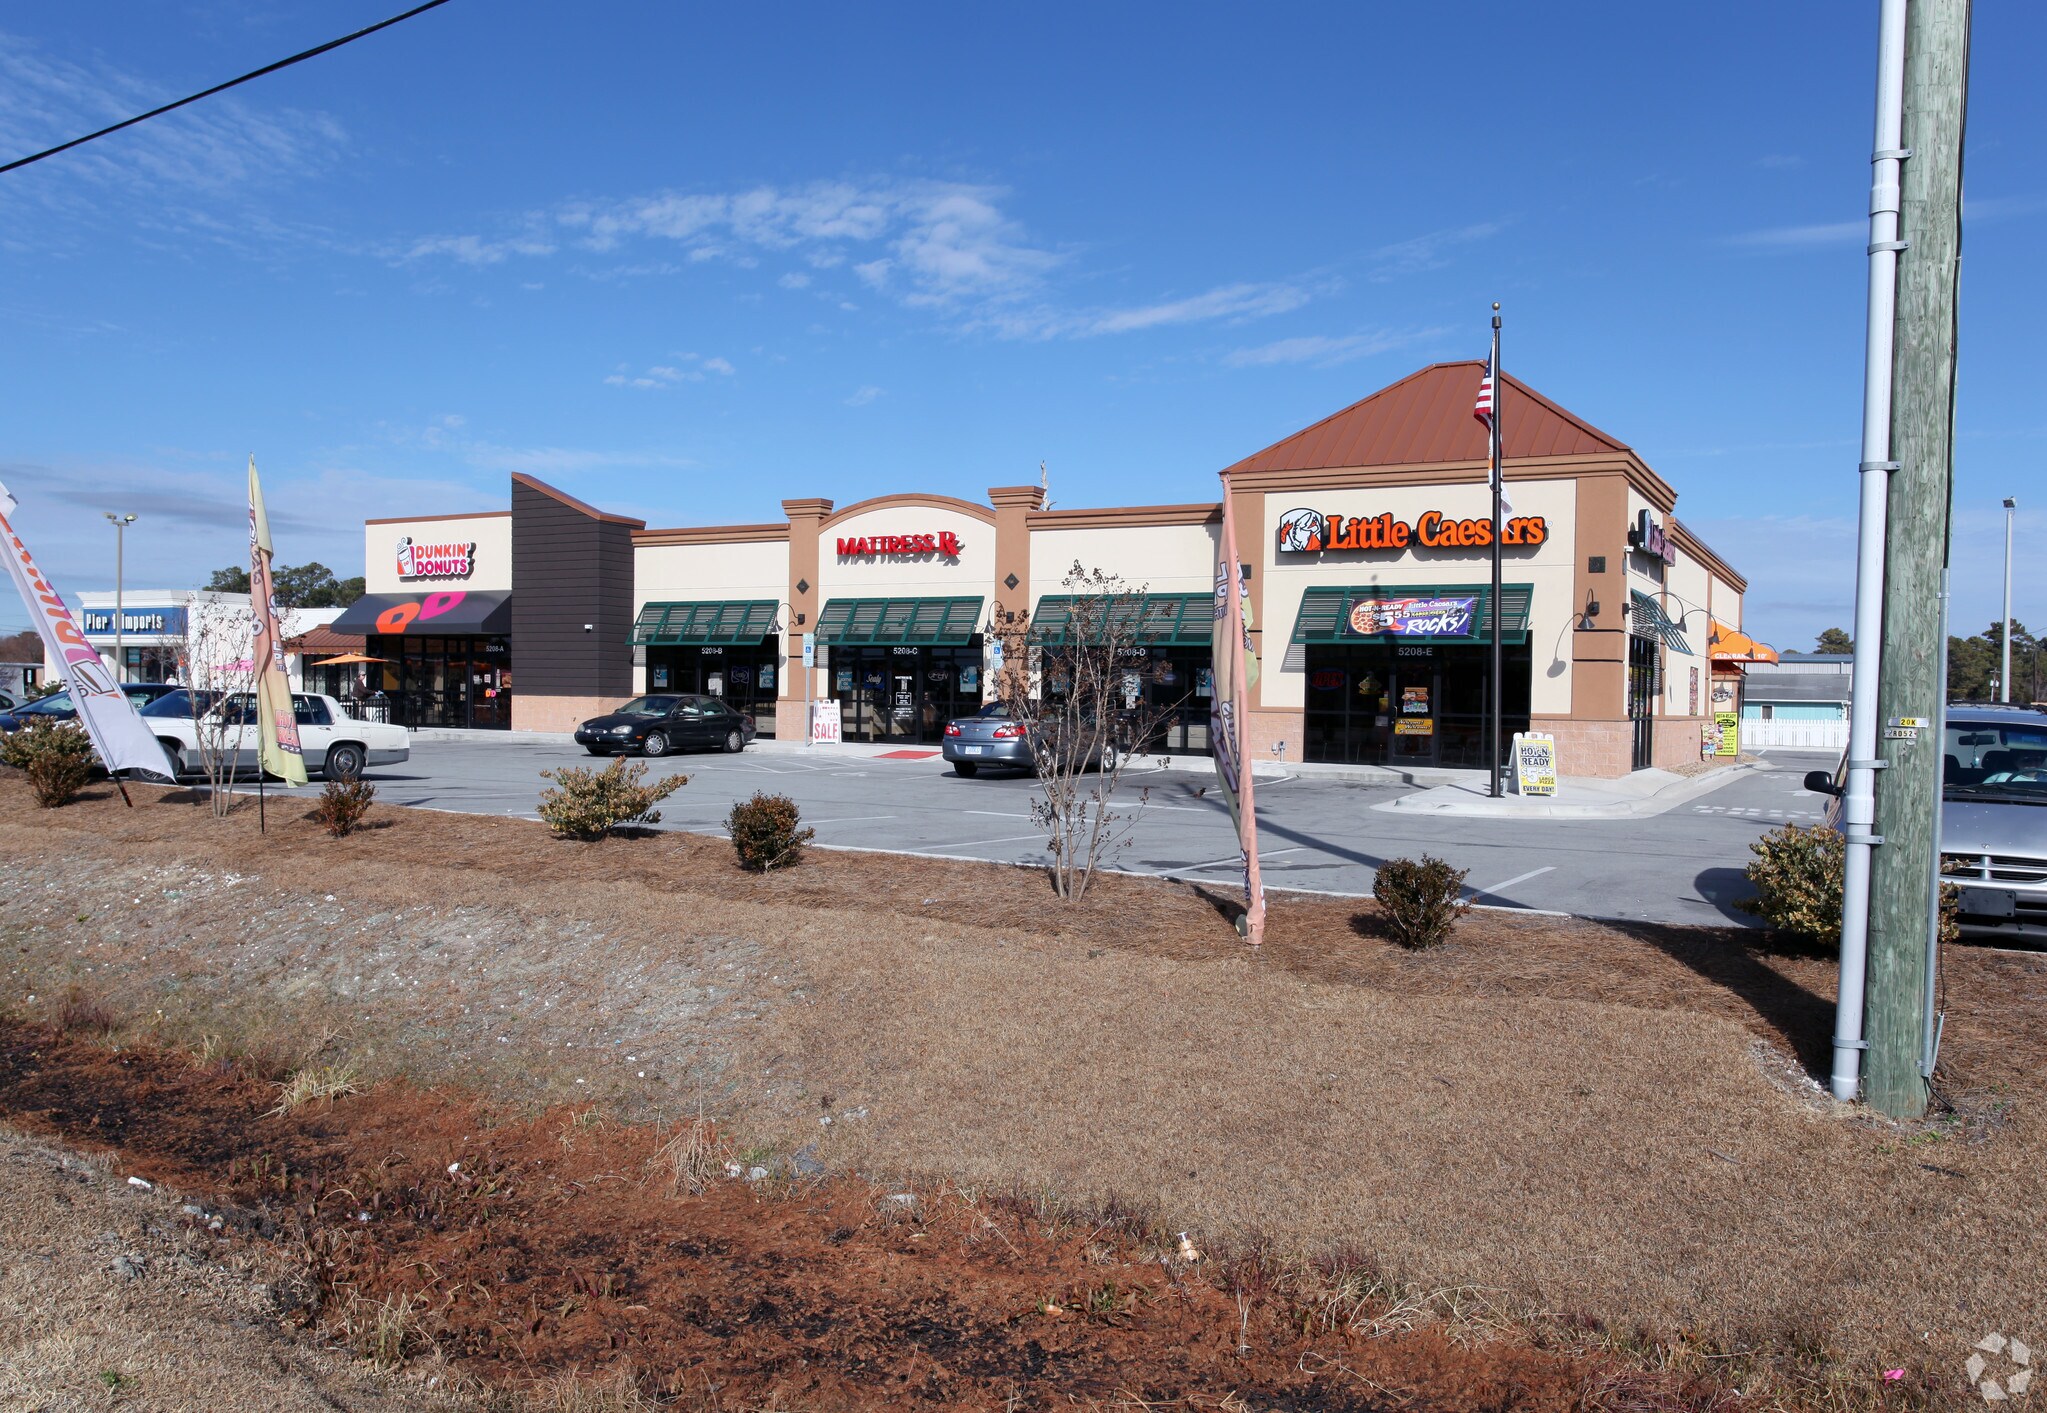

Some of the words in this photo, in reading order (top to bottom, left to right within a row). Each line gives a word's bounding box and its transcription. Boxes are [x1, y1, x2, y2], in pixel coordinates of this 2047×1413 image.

[1326, 512, 1409, 550] Little
[416, 543, 469, 559] DUNKIN'
[837, 533, 935, 555] MATTRESS
[416, 559, 467, 574] DONUTS
[86, 613, 107, 629] Pier
[122, 613, 162, 631] imports
[1406, 613, 1469, 634] ROCKS!
[1398, 647, 1433, 656] 5208-E
[814, 723, 838, 740] SALE
[1522, 757, 1550, 766] READY
